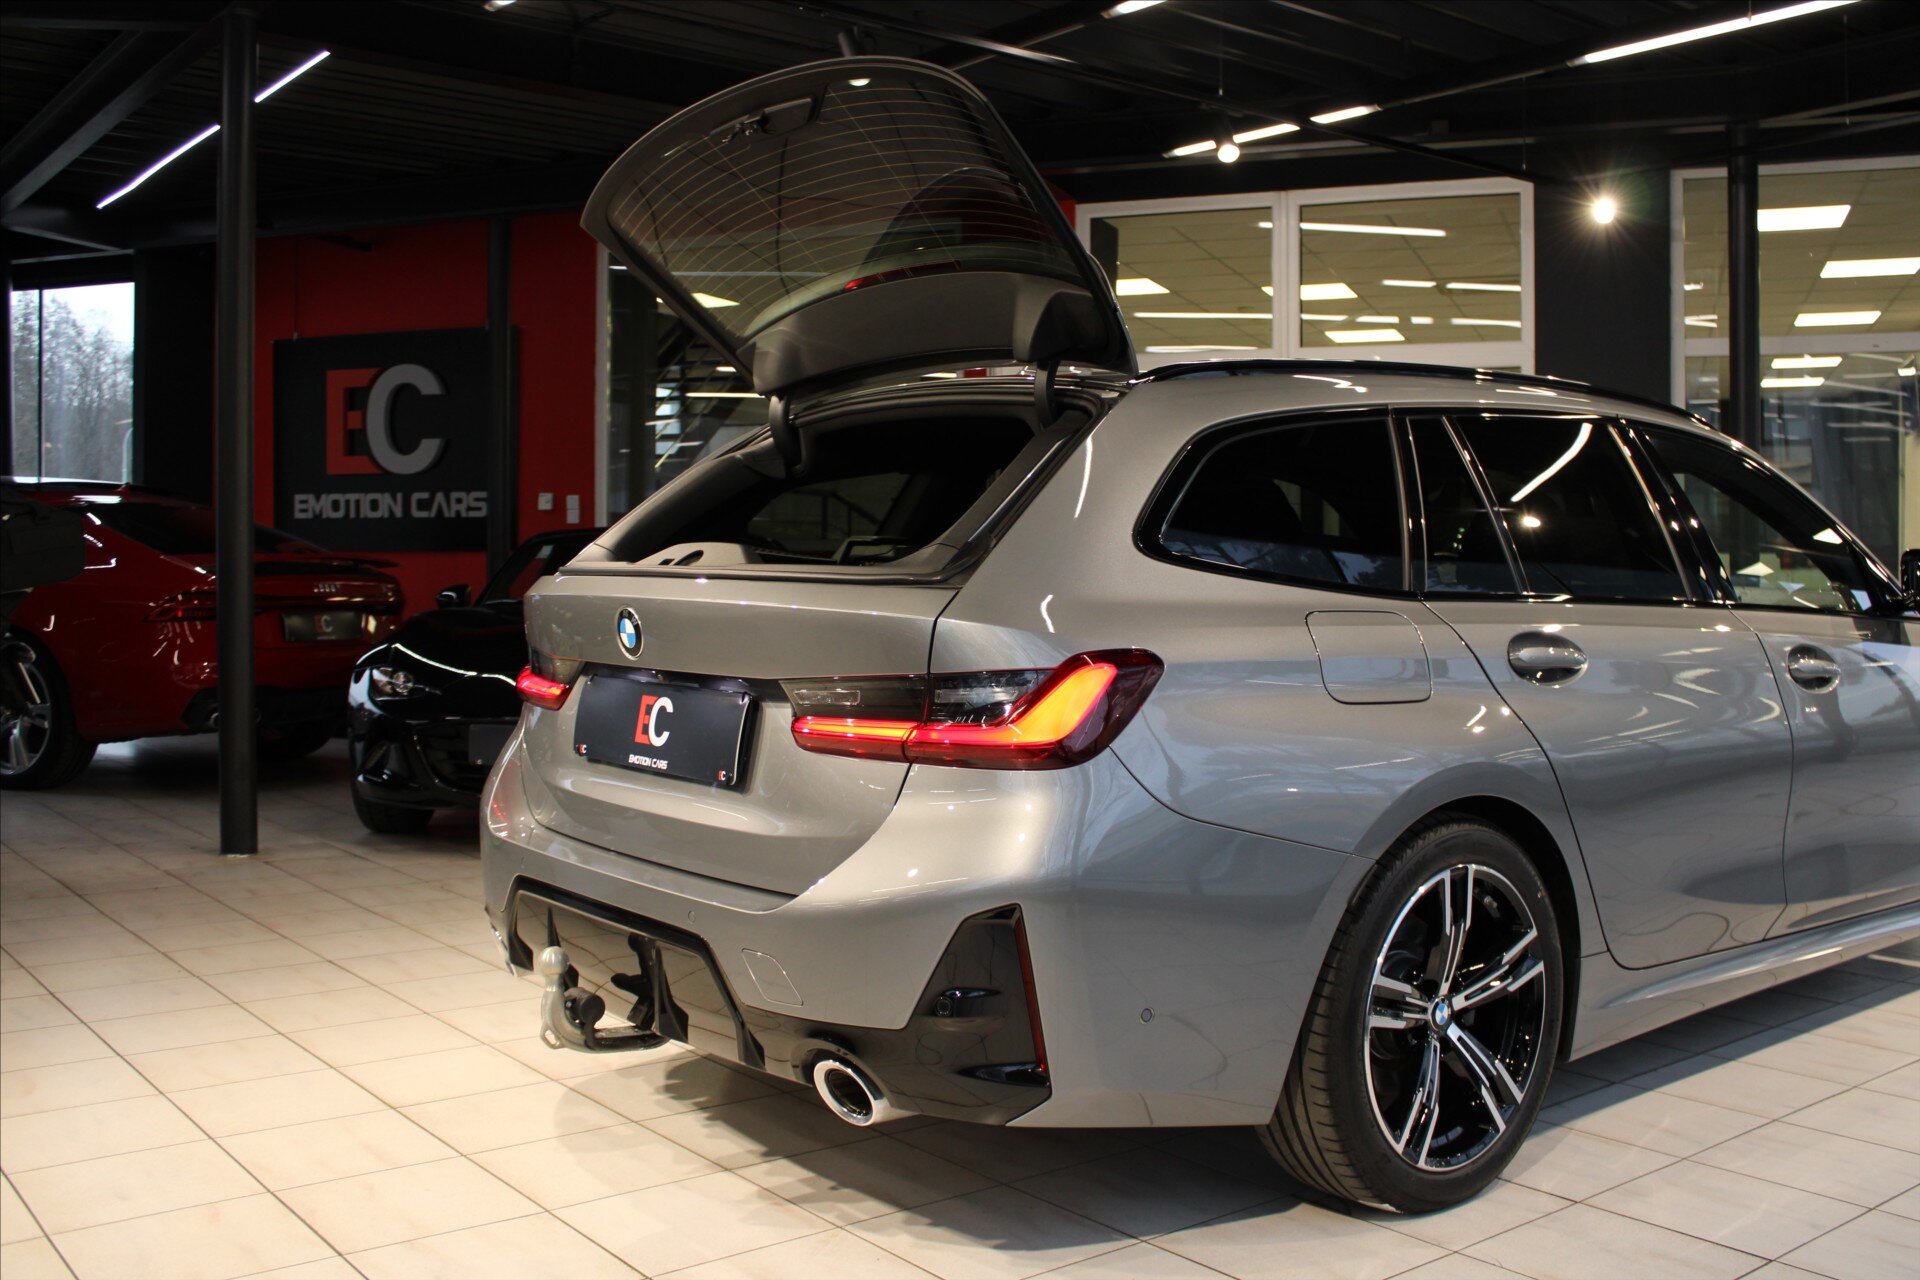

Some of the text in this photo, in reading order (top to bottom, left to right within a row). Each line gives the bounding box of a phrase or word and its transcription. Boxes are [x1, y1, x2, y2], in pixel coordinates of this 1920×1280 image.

[326, 363, 445, 475] EC
[294, 491, 488, 519] EMOTION CARS
[634, 694, 673, 747] EC
